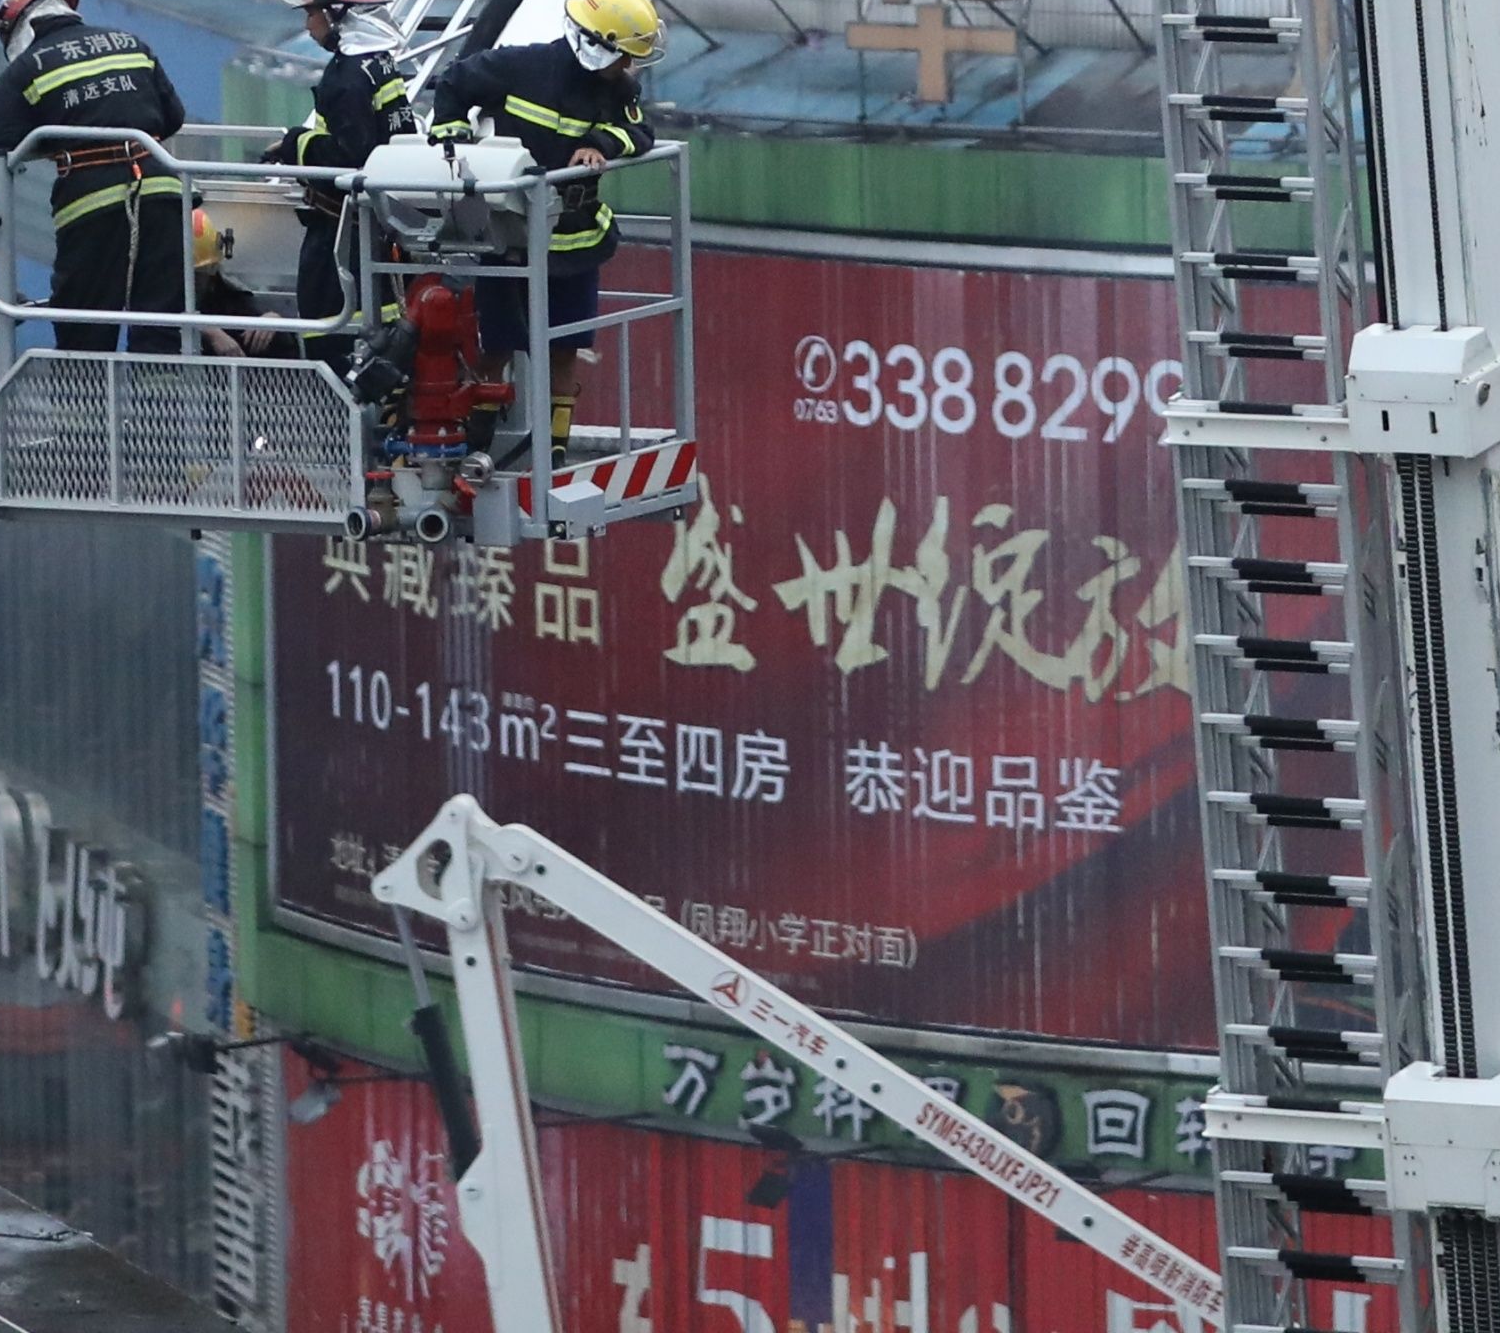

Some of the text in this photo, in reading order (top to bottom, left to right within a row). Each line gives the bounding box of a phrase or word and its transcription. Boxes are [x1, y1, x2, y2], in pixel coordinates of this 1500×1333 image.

[32, 32, 138, 71] 广东消防
[63, 74, 137, 109] 清远支队
[842, 339, 978, 434] 338
[322, 533, 602, 647] 典藏臻品
[660, 475, 1193, 702] 盛世绽放
[845, 738, 1125, 835] 恭迎品鉴
[749, 997, 829, 1056] 三一汽车
[915, 1101, 1062, 1209] SYM5430JXFJP21
